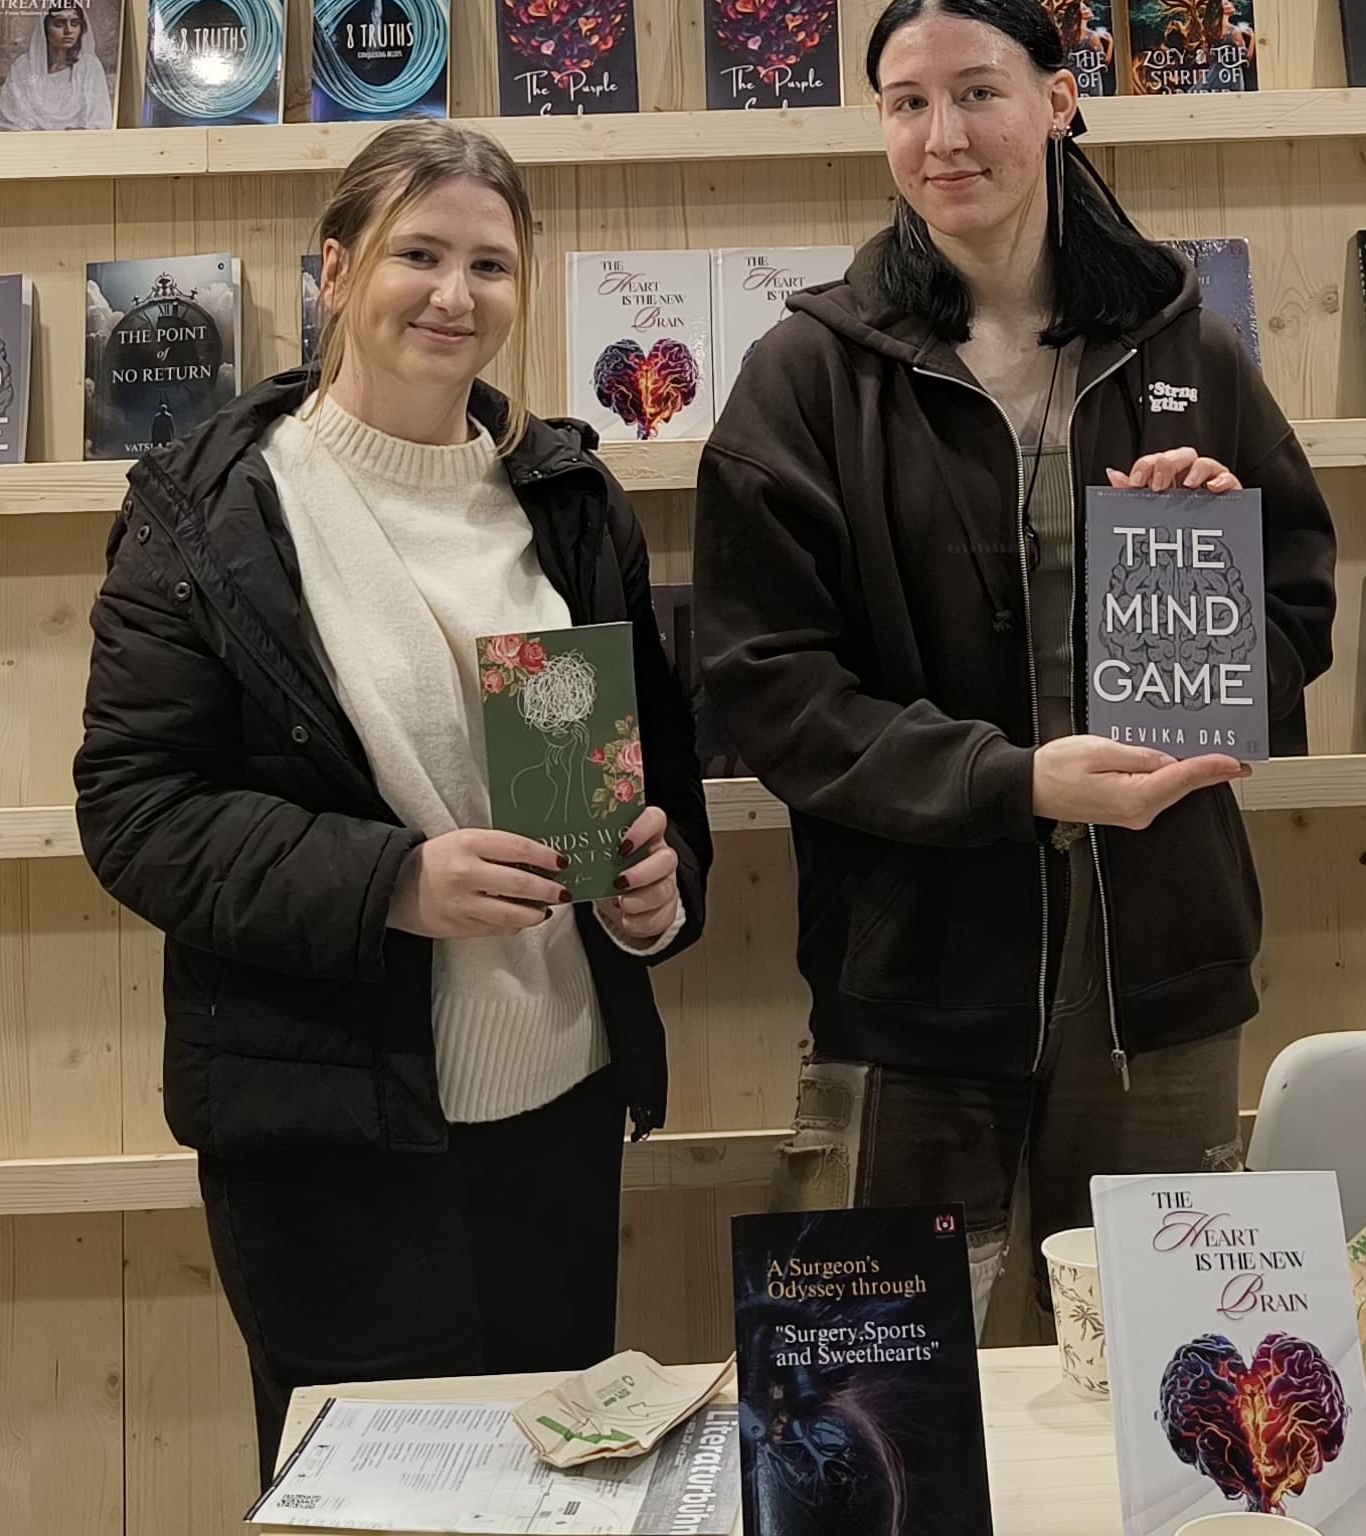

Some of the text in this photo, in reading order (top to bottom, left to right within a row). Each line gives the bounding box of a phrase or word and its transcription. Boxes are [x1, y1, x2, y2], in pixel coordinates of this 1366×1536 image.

[194, 26, 247, 52] TRUTHS
[360, 22, 414, 48] TRUTHS
[1069, 49, 1108, 73] THE
[1143, 44, 1250, 69] ZOEY THE
[514, 68, 619, 104] The Purple
[720, 64, 824, 98] The Purple
[1078, 73, 1100, 88] OF
[1150, 68, 1242, 90] SPIRIT OF
[599, 260, 624, 271] THE
[743, 256, 769, 266] THE
[118, 325, 207, 345] THE POINT
[156, 347, 170, 361] of
[112, 364, 213, 385] NO RETURN
[1113, 527, 1225, 569] THE
[1106, 593, 1239, 636] MIND
[1093, 660, 1254, 706] GAME
[1111, 725, 1236, 747] DEVIKA DAS
[1151, 1191, 1193, 1209] THE
[1153, 1210, 1260, 1252] HEART
[767, 1256, 880, 1280] A Surgeon's
[1196, 1250, 1306, 1272] IS THE NEW
[768, 1275, 926, 1302] Odyssey through
[1216, 1272, 1309, 1321] BRAIN
[776, 1341, 940, 1367] and Sweethearts"
